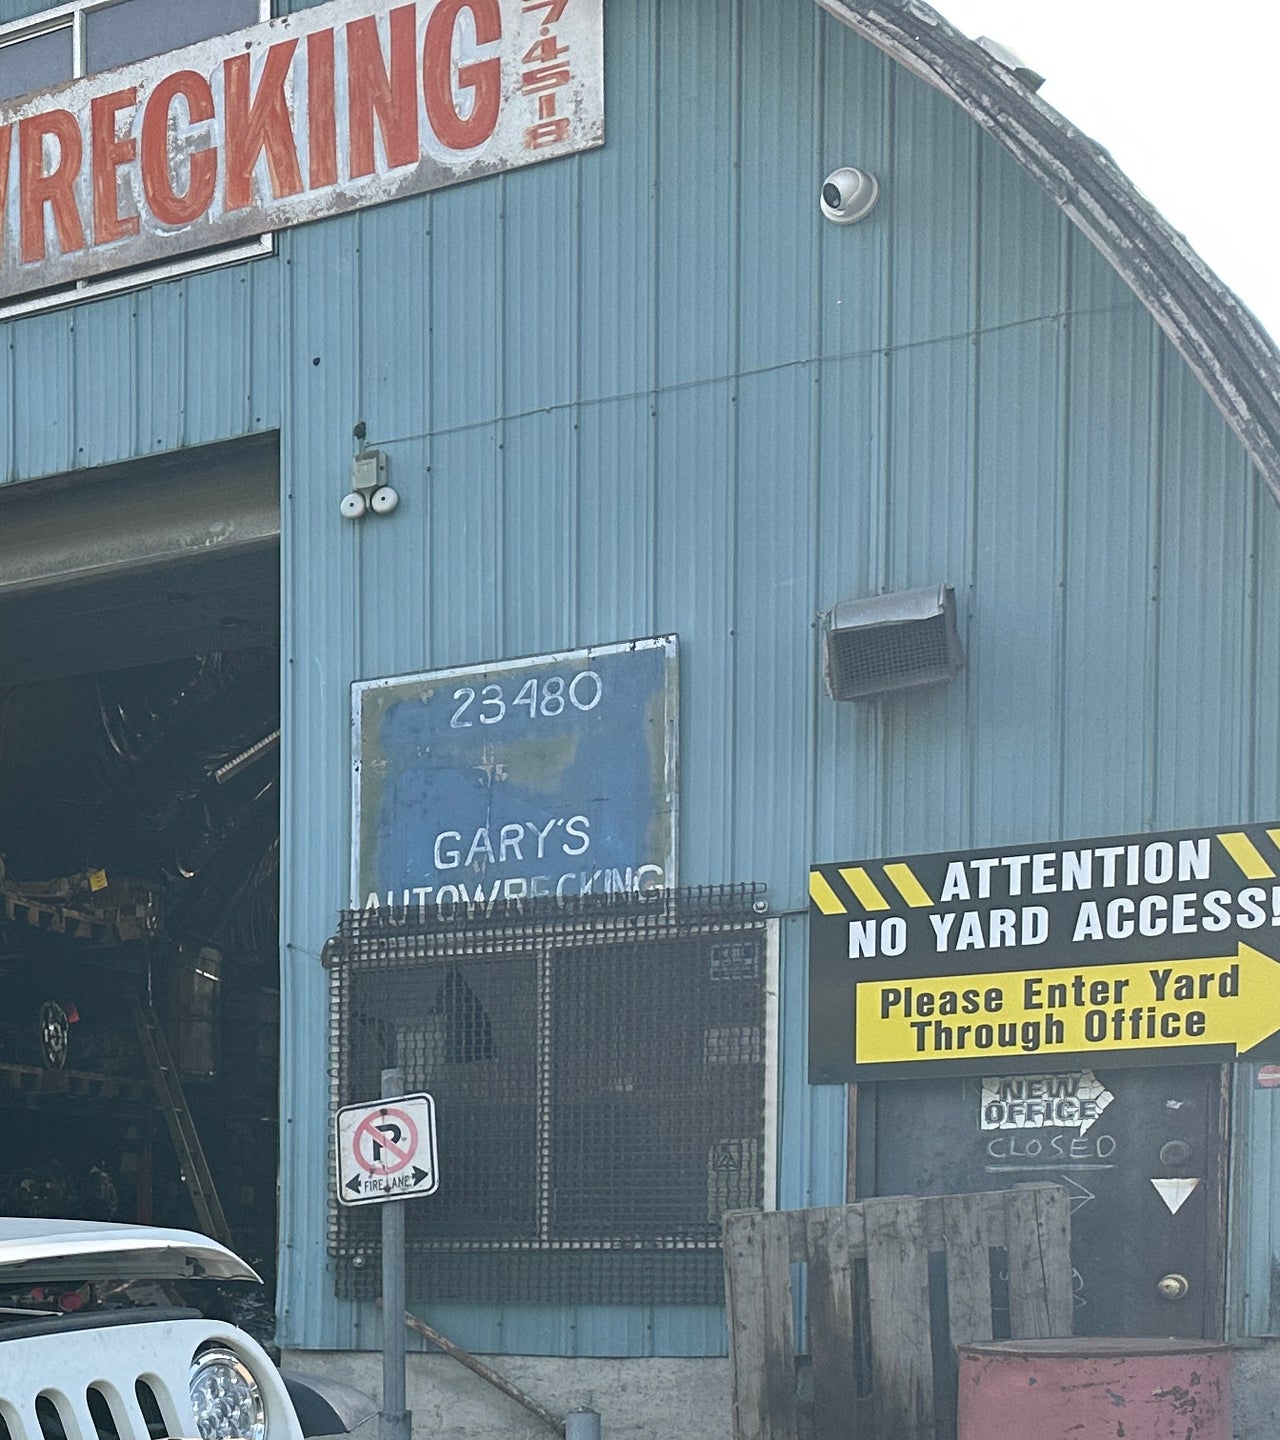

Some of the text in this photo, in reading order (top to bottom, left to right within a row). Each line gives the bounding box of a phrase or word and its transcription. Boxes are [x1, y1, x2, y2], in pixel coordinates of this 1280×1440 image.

[449, 671, 603, 729] 23480
[433, 815, 591, 870] GARY'S
[940, 837, 1211, 902] ATTENTION
[848, 885, 1280, 959] NO YARD ACCESS!
[880, 964, 1240, 1020] Please Enter Yard
[910, 1008, 1207, 1052] Through Office
[985, 1100, 1097, 1125] OFFICE
[1001, 1077, 1079, 1100] NEW
[988, 1135, 1117, 1158] CLOSED
[364, 1179, 384, 1193] FIRE
